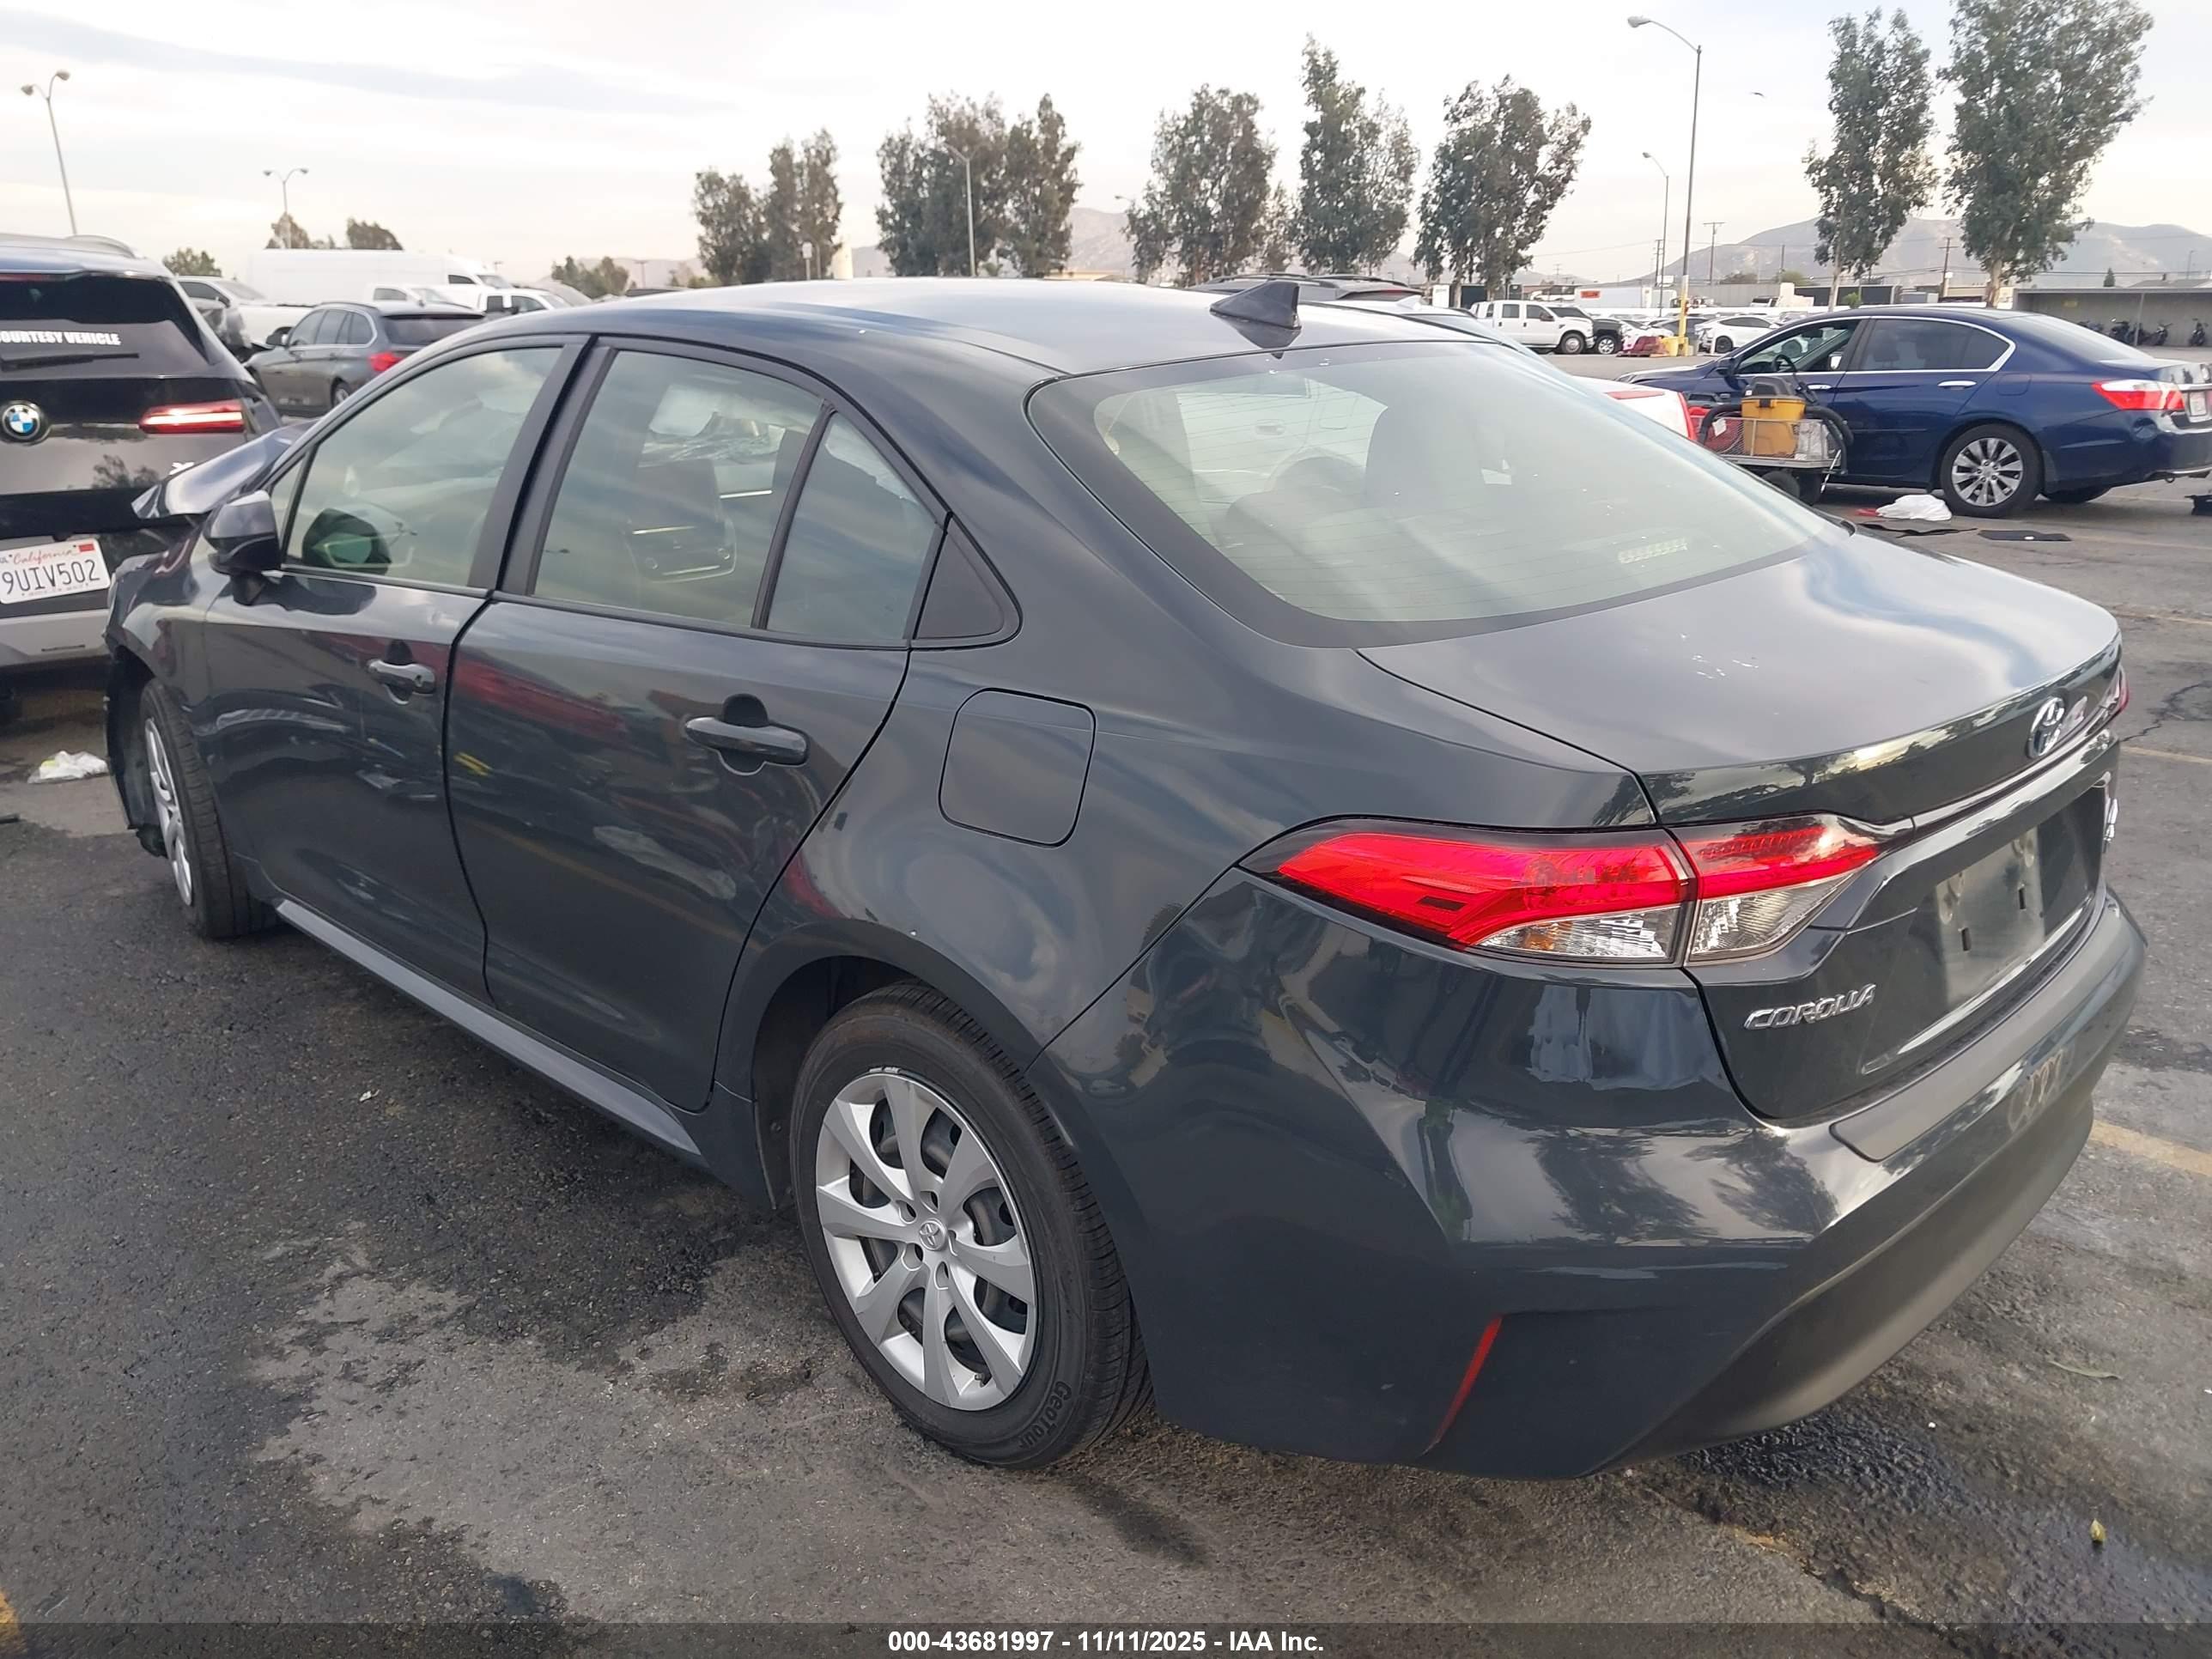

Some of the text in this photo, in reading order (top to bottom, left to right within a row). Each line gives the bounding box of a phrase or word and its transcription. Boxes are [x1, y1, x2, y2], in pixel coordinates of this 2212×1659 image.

[0, 331, 121, 345] OURTESY VEHICLE
[13, 549, 74, 565] California
[2, 559, 100, 595] 9UIV502
[1743, 983, 1876, 1030] COROLLA
